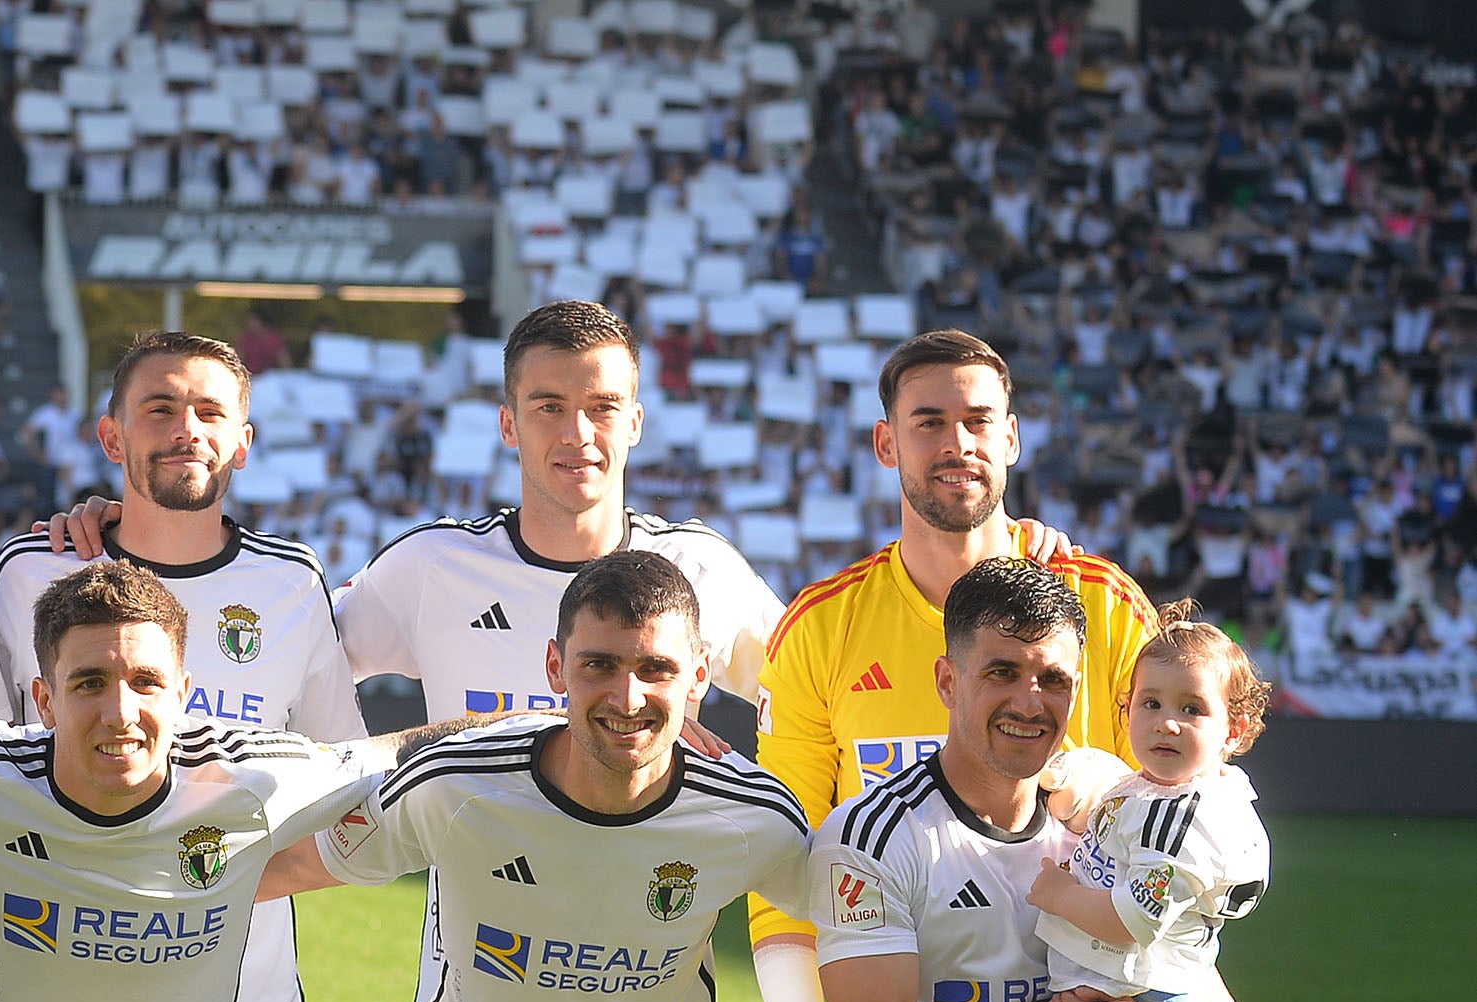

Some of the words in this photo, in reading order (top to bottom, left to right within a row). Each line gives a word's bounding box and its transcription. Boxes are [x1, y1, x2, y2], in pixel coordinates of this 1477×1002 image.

[185, 687, 264, 724] ALE
[334, 823, 349, 848] LIGA
[73, 904, 229, 940] REALE
[840, 909, 878, 924] LALIGA
[70, 935, 220, 964] SEGUROS
[541, 940, 688, 972] REALE
[537, 968, 677, 994] SEGUROS
